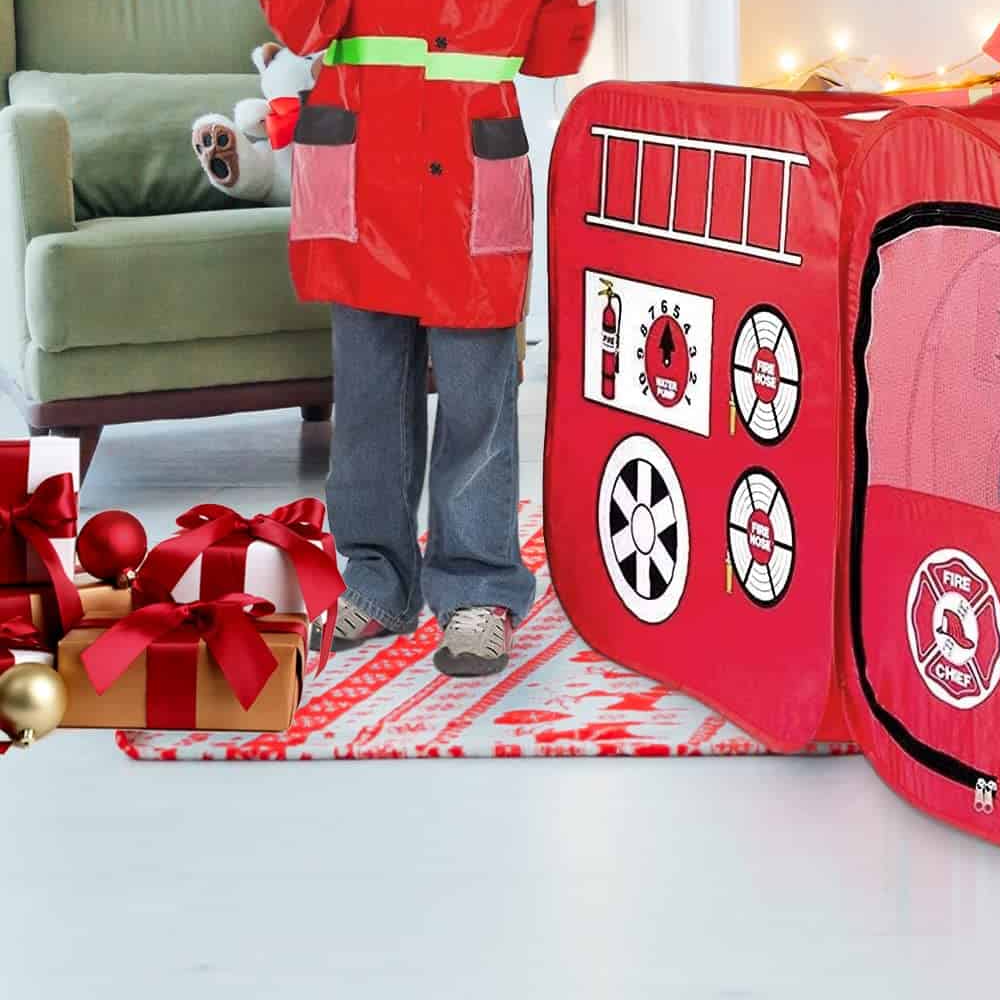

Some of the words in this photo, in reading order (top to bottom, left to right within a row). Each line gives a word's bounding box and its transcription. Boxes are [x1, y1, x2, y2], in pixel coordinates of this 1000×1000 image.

[660, 299, 669, 315] 6
[672, 304, 681, 320] 5
[943, 571, 971, 592] FIRE
[934, 664, 973, 689] CHIEF
